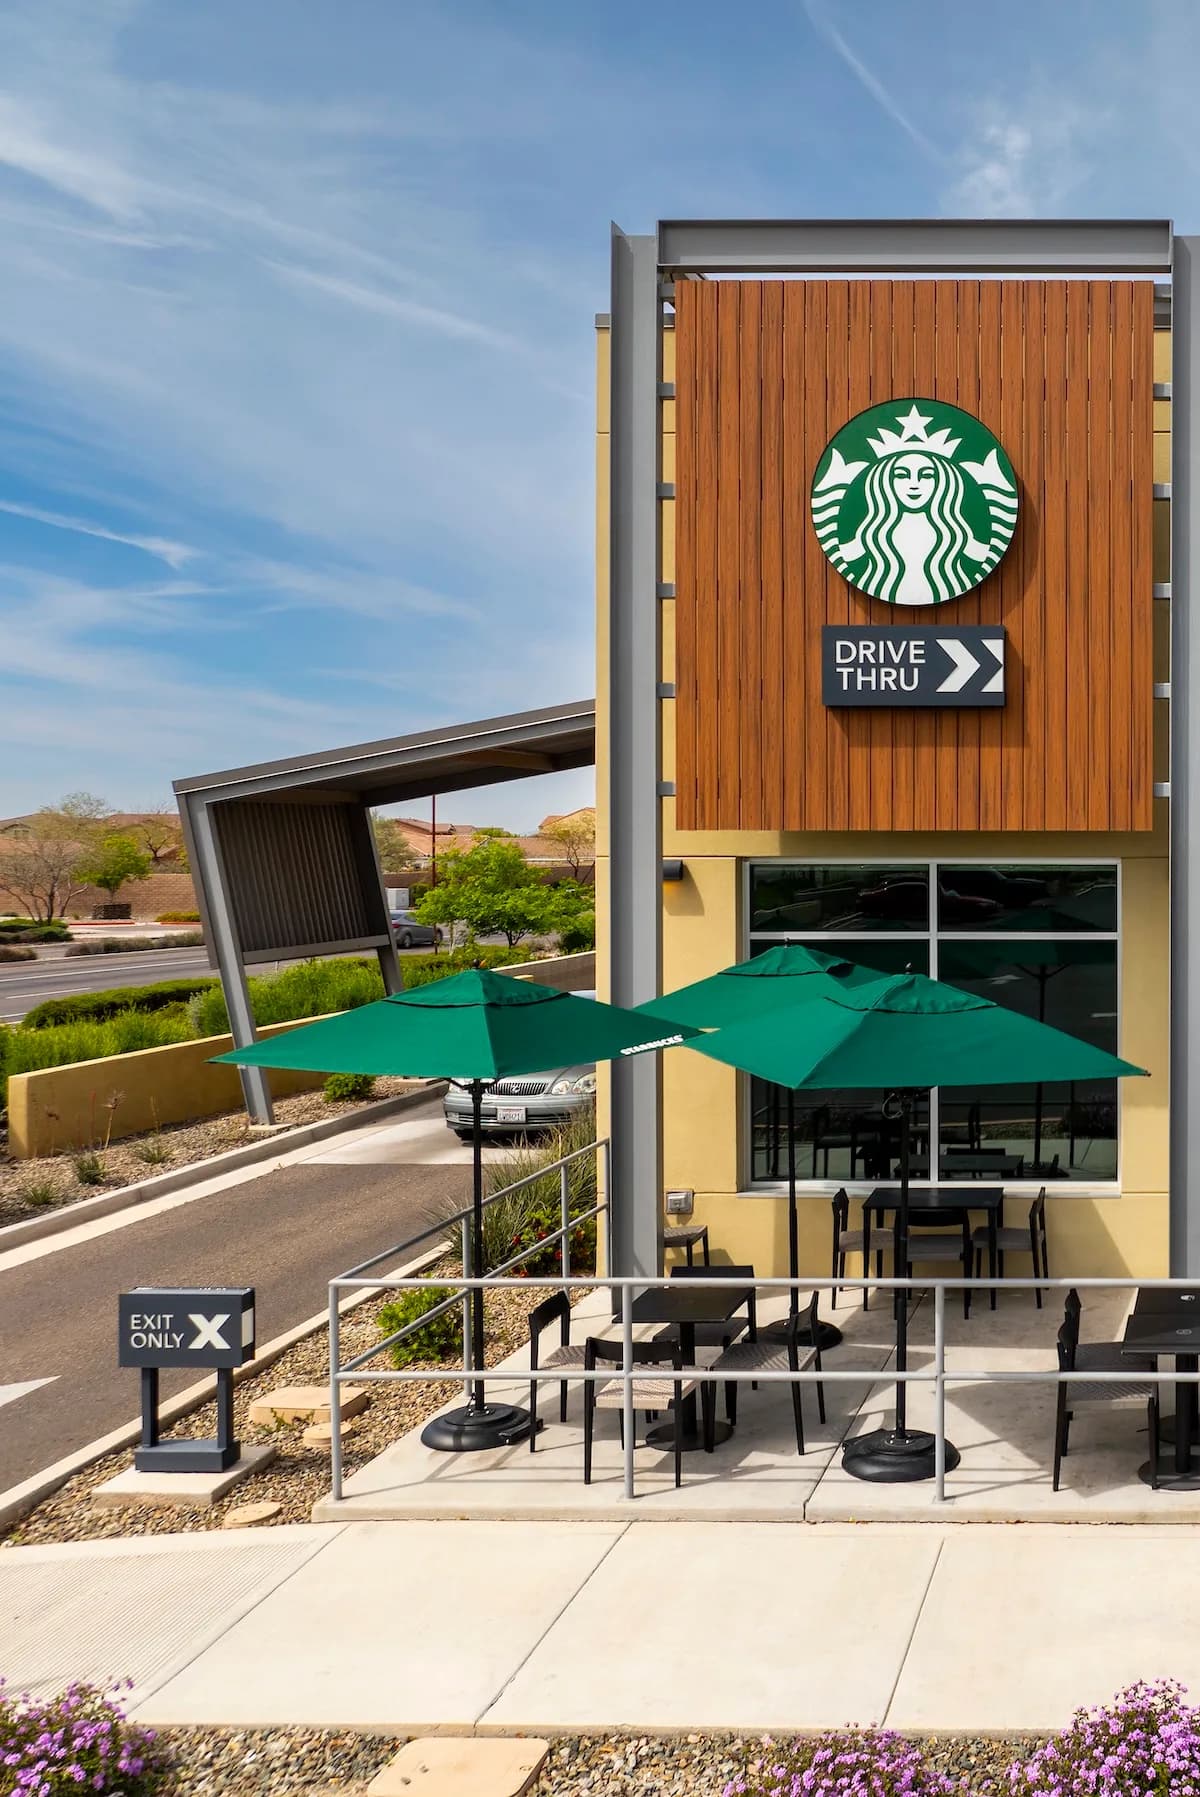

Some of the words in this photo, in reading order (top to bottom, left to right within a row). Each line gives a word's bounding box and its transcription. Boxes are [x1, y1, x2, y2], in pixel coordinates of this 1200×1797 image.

[835, 640, 926, 664] DRIVE
[836, 667, 919, 691] THRU
[130, 1314, 174, 1330] EXIT
[130, 1332, 184, 1349] ONLY
